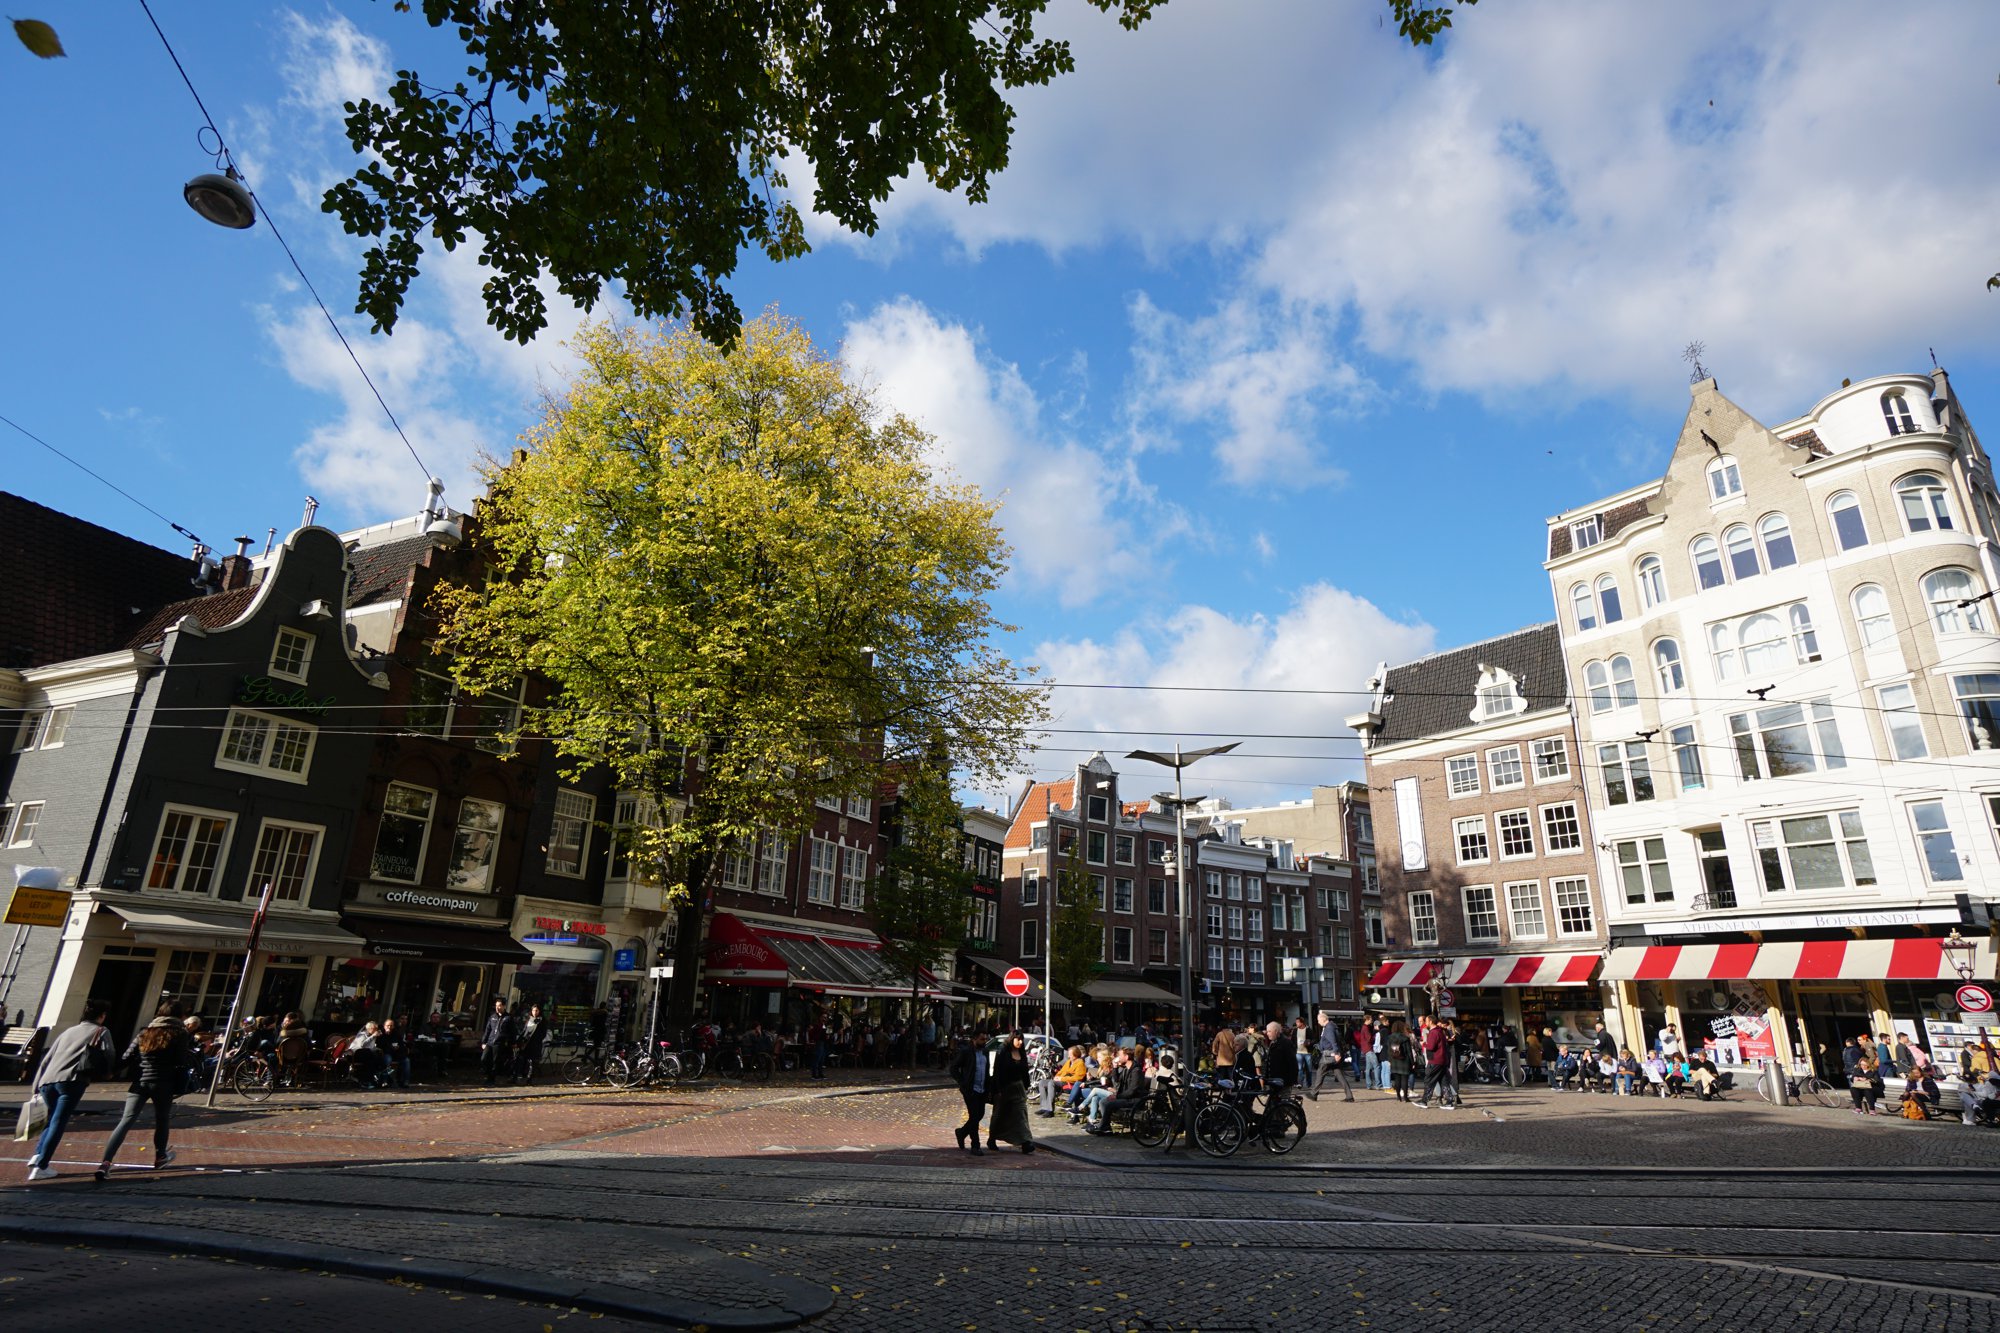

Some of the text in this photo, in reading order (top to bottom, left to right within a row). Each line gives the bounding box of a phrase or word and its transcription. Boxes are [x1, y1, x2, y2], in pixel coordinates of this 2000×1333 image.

[241, 674, 337, 717] Grolsch
[374, 852, 409, 866] RAINBOW
[386, 890, 479, 912] coffeecompany
[1681, 920, 1761, 933] ATHENAEUM
[1815, 913, 1925, 927] BOEKHANDEL
[382, 948, 423, 957] coffeecompany
